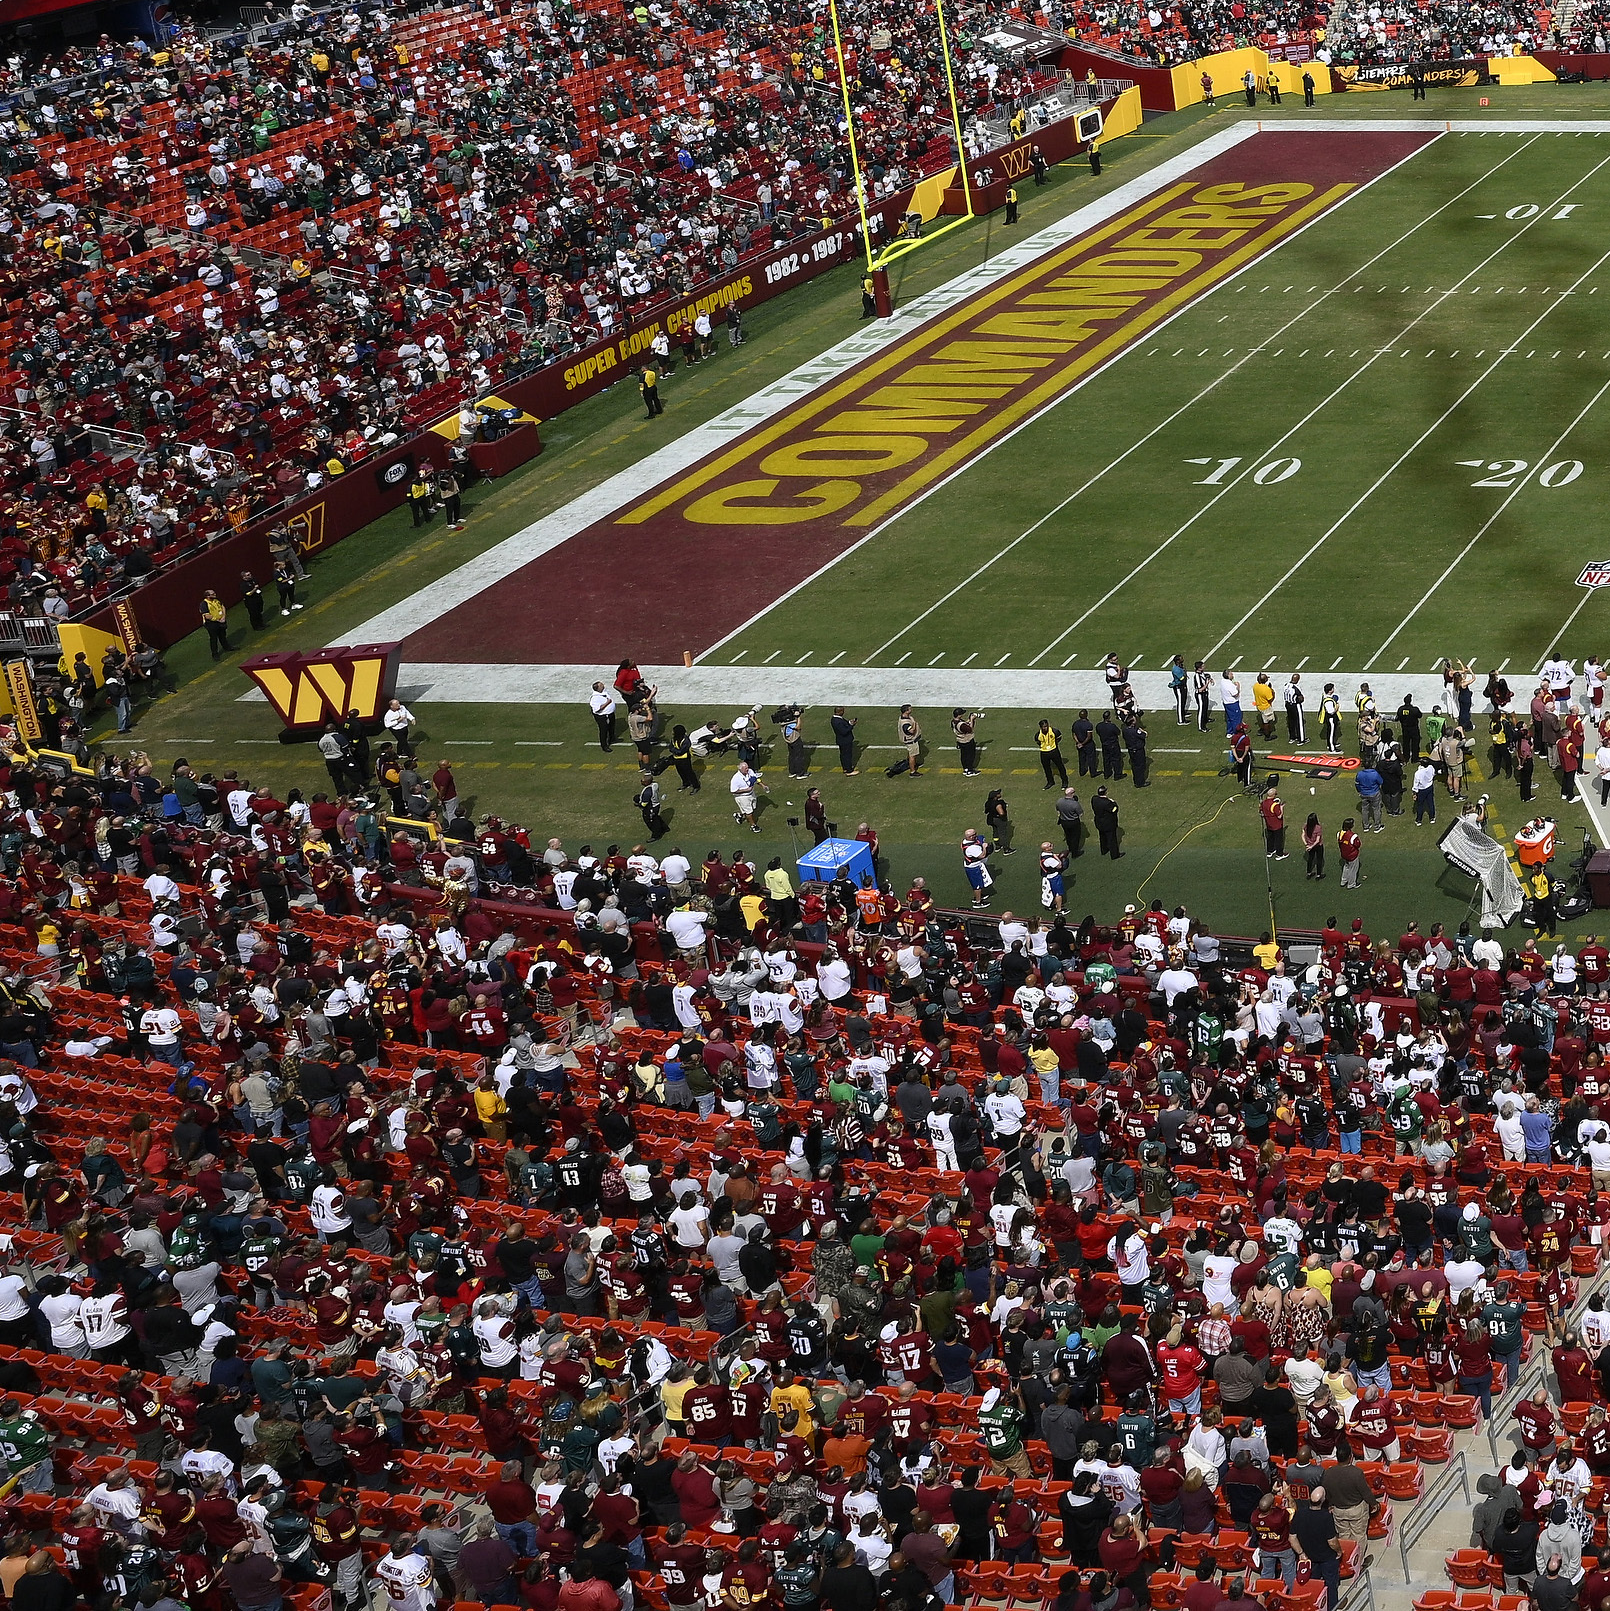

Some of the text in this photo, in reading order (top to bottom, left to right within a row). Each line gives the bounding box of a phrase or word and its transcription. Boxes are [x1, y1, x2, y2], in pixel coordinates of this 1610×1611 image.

[1382, 67, 1466, 86] COMMNDERS!
[1023, 230, 1073, 250] US
[764, 231, 843, 282] 1982 1987
[563, 351, 618, 392] SUPER
[666, 275, 754, 336] CHAMPIONS
[682, 180, 1315, 526] COMMANDERS
[761, 326, 893, 398] TAKES
[704, 408, 768, 432] IT
[1192, 456, 1302, 486] 10
[1470, 459, 1585, 489] 20
[1548, 670, 1561, 682] 72
[12, 666, 38, 738] WASHINGTON
[563, 1170, 577, 1185] 43
[692, 1404, 716, 1421] 85
